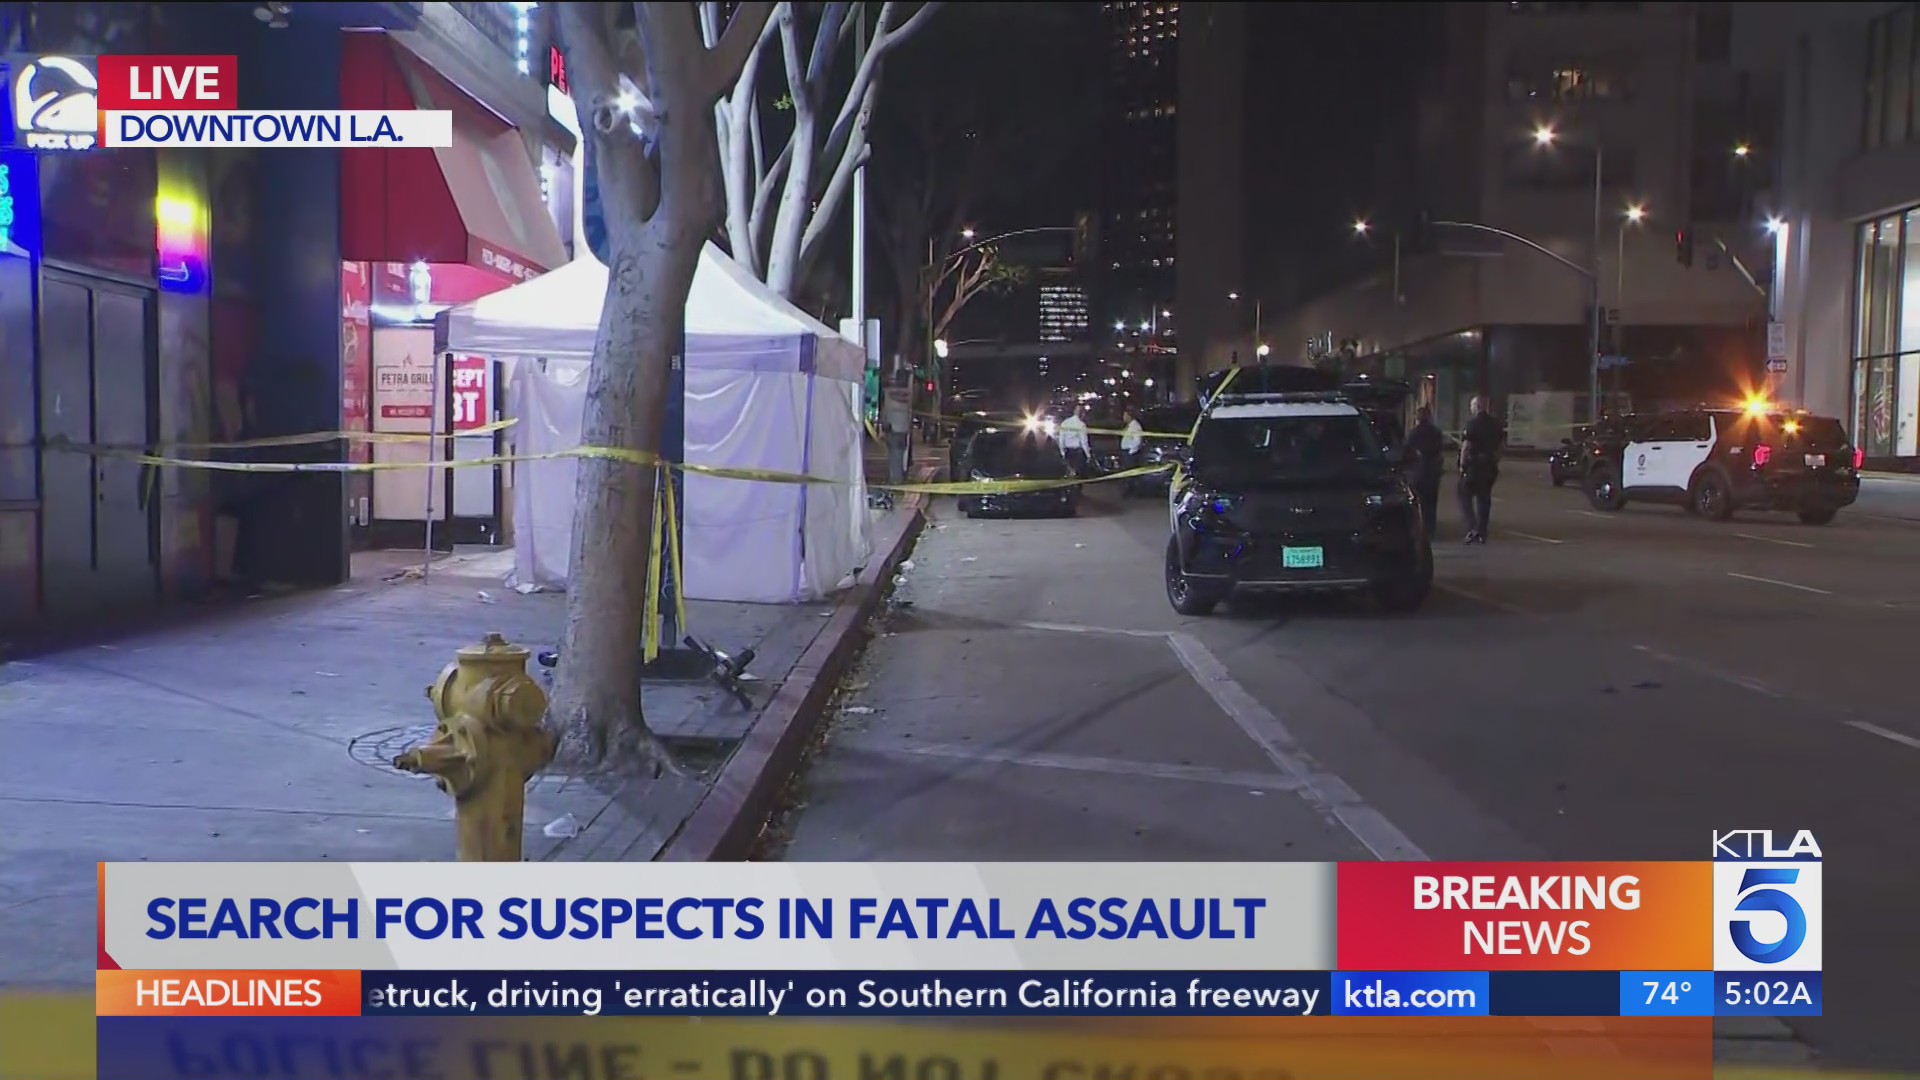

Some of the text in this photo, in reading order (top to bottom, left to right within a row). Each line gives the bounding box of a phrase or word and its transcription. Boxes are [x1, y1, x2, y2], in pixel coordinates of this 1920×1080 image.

[550, 46, 570, 95] PE
[27, 133, 95, 150] PICK UP
[381, 373, 408, 385] PETRA
[453, 391, 480, 422] BT
